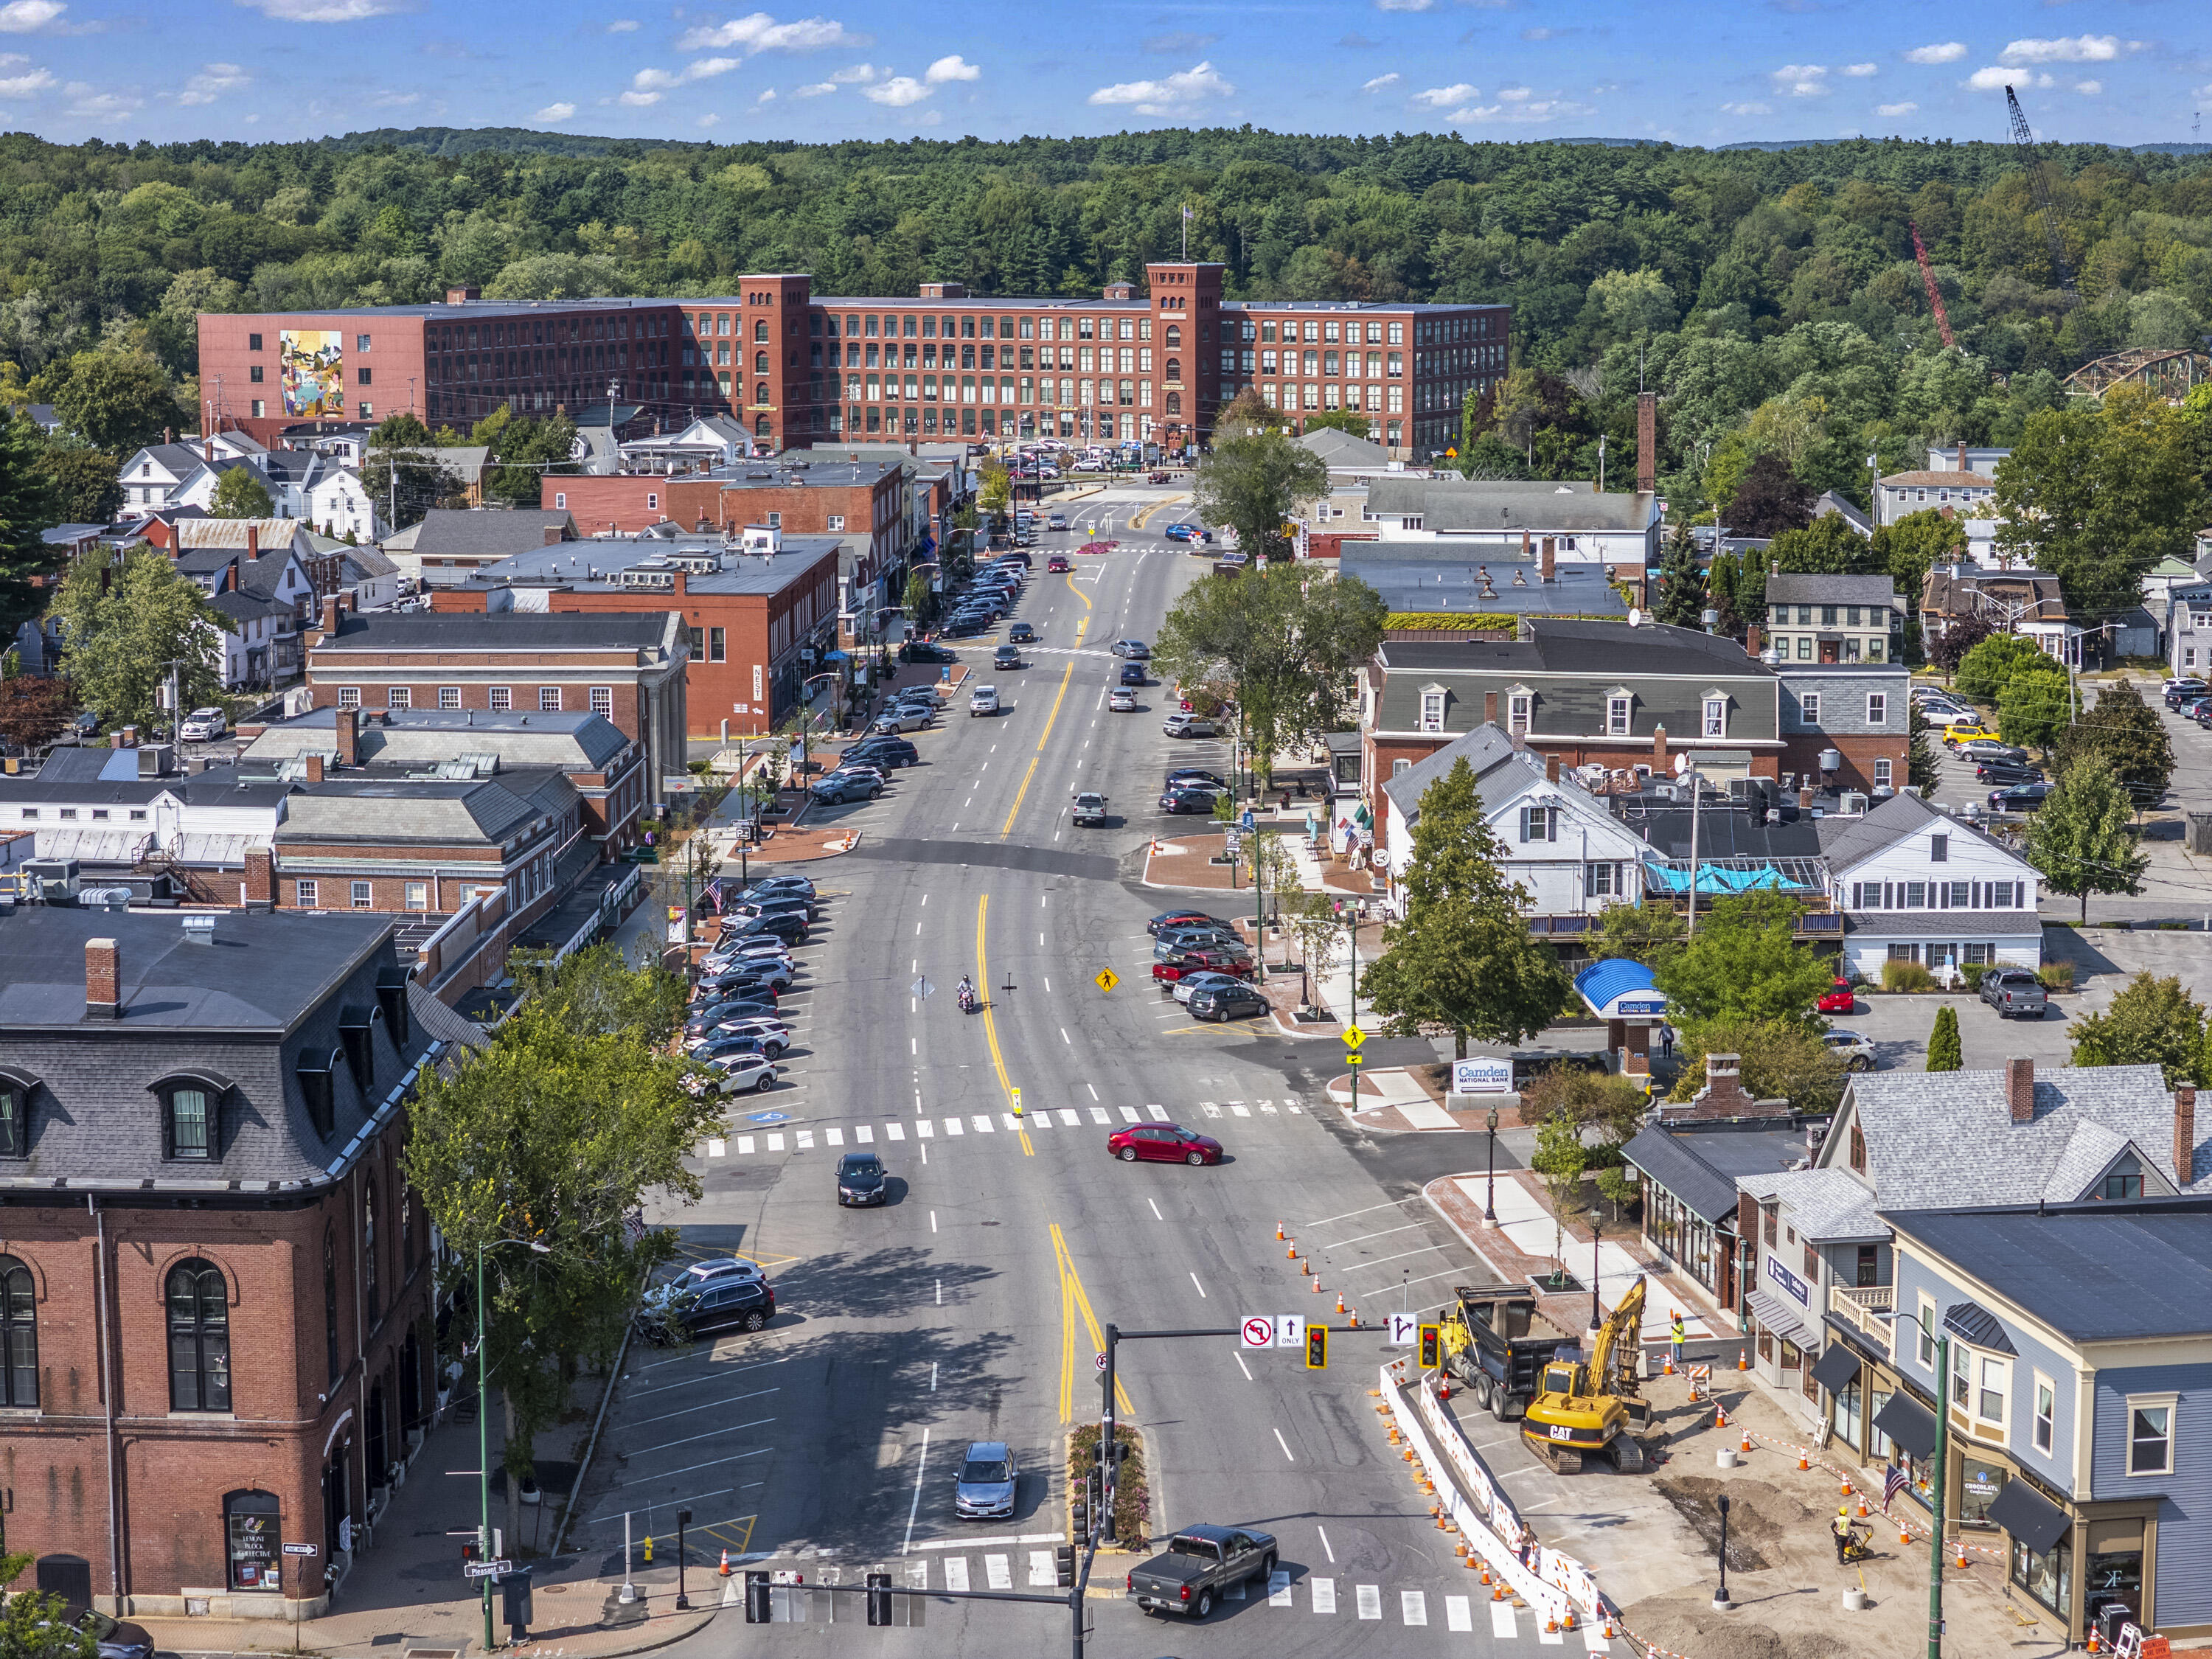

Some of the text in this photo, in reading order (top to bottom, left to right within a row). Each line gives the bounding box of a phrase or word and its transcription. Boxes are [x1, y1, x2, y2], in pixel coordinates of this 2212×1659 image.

[1458, 1066, 1509, 1077] Camden
[1550, 1425, 1573, 1441] CAT
[471, 1566, 497, 1575] Pleasant
[2143, 1639, 2167, 1649] BUSINESSES
